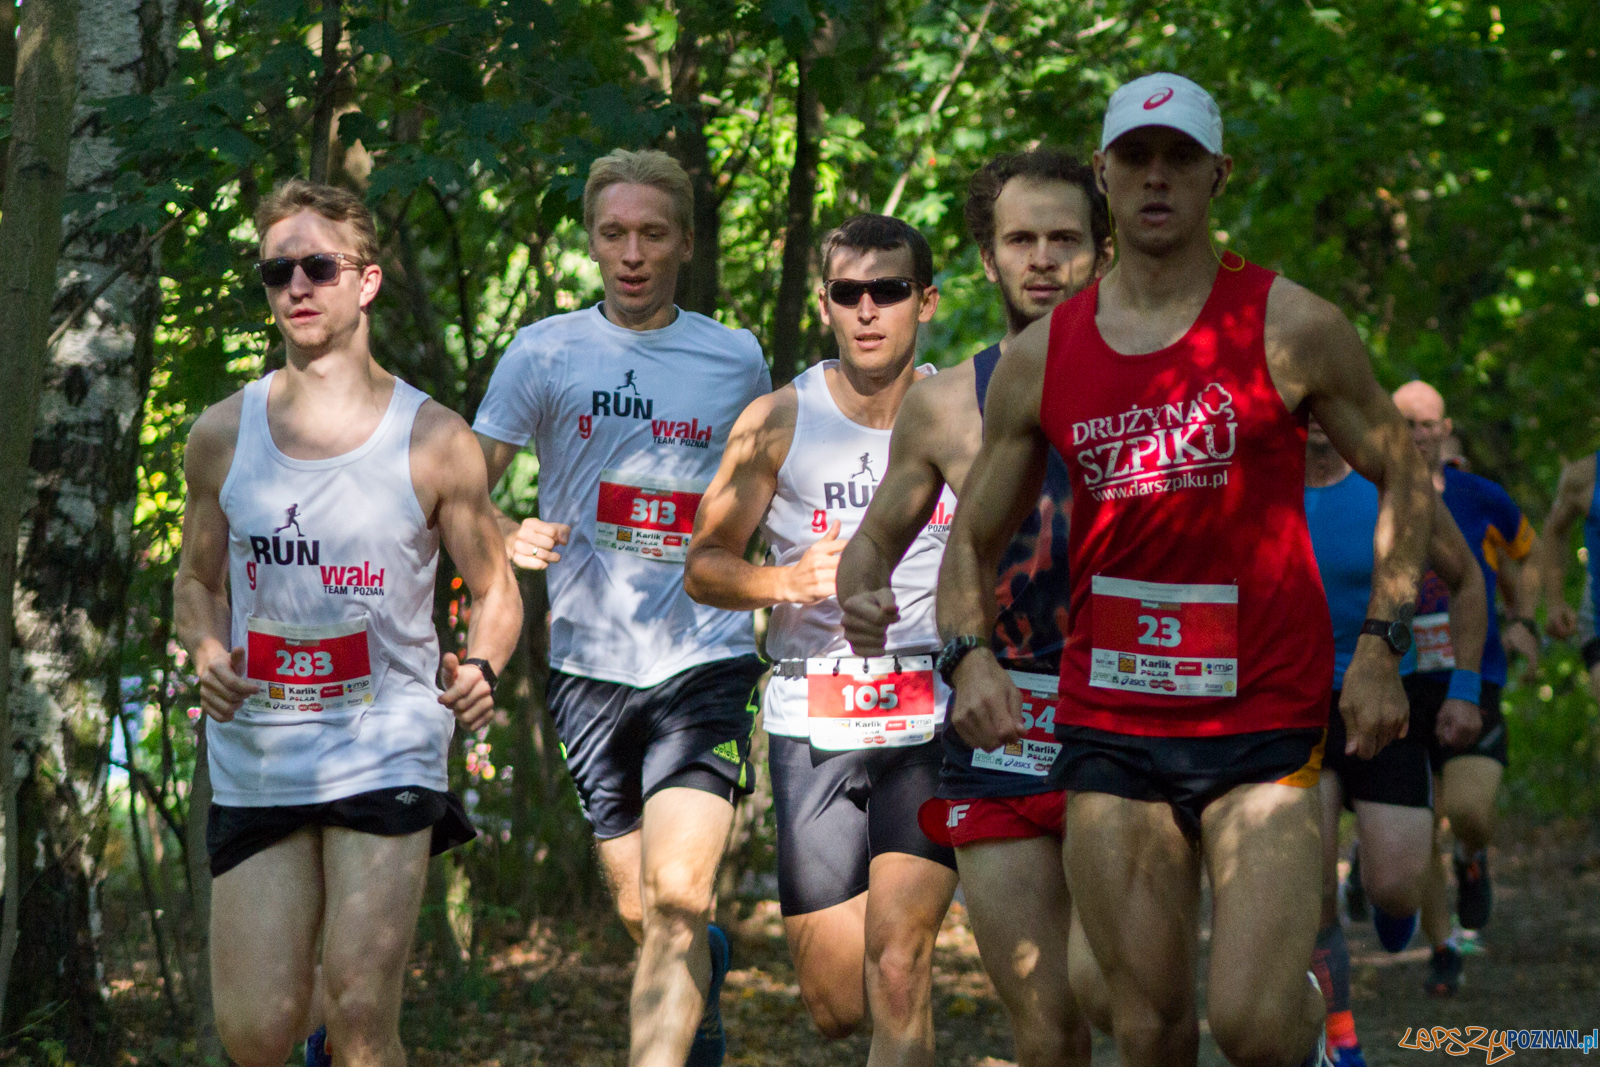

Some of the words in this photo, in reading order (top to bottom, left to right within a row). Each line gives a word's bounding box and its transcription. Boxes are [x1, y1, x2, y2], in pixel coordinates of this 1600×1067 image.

[593, 391, 653, 420] RUN
[652, 418, 712, 442] wald
[1072, 400, 1207, 446] DRUŻYNA
[653, 436, 676, 445] TEAM
[1077, 422, 1238, 485] SZPIKU
[824, 481, 879, 510] RU
[1092, 470, 1228, 502] www.darszpiku.pl
[630, 498, 677, 526] 313
[636, 531, 661, 540] Karlik
[250, 535, 320, 566] RUN
[320, 561, 385, 587] wald
[324, 585, 348, 595] TEAM
[1138, 615, 1182, 647] 23
[276, 650, 334, 677] 283
[1140, 658, 1172, 669] Karlik
[288, 687, 317, 695] Karlik
[842, 684, 898, 711] 105
[855, 720, 882, 728] Karlik
[713, 746, 740, 765] adidas
[1028, 743, 1057, 754] Karlik
[1013, 760, 1031, 769] asics
[395, 791, 420, 804] 4F
